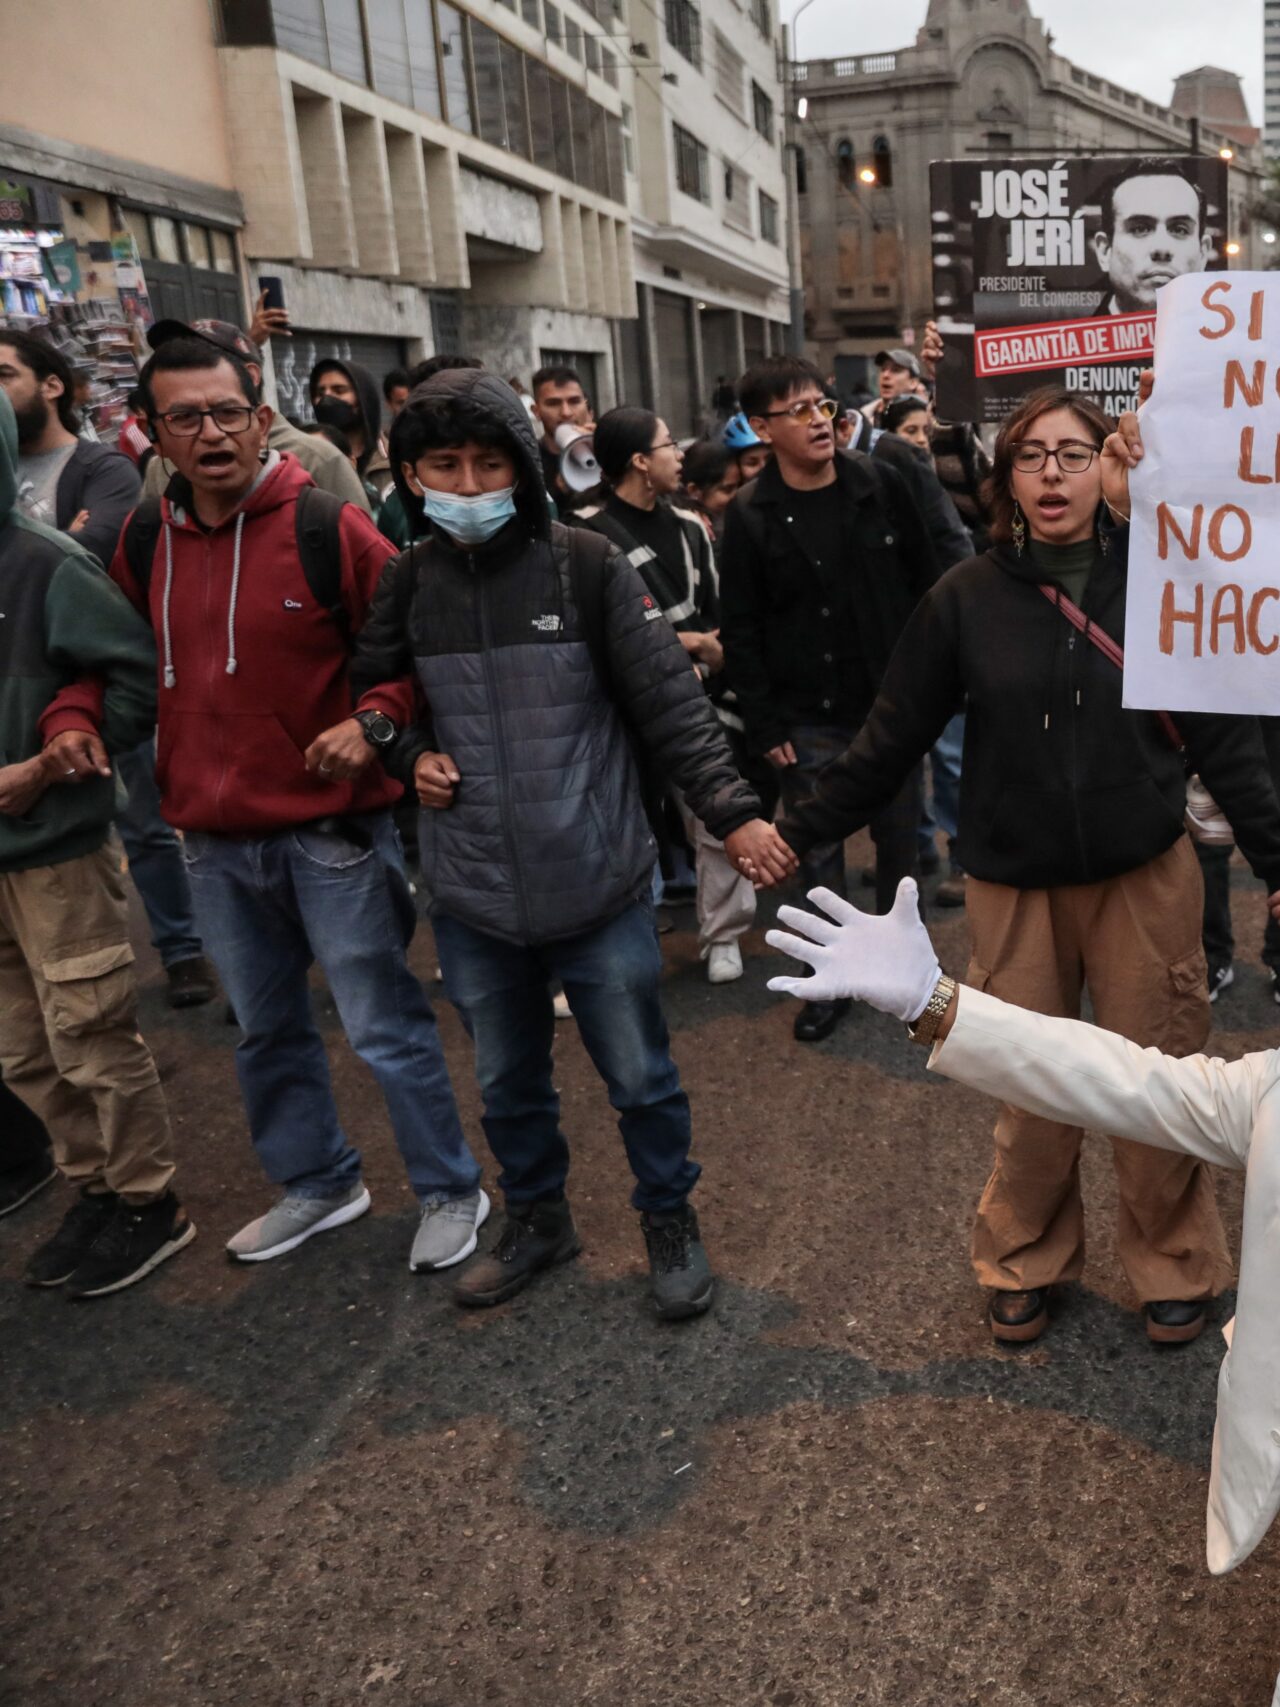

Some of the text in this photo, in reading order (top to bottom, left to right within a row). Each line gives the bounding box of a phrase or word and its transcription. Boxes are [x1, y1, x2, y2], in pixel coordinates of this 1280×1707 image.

[977, 160, 1070, 219] JOSÉ
[1007, 209, 1086, 267] JERÍ
[979, 275, 1047, 292] PRESIDENTE
[1019, 290, 1101, 308] DEL CONGRESO
[1199, 280, 1265, 342] SI
[986, 328, 1081, 367] GARANTÍA
[1083, 327, 1110, 355] DE
[1065, 366, 1153, 392] DENUNC
[1155, 501, 1253, 563] NO
